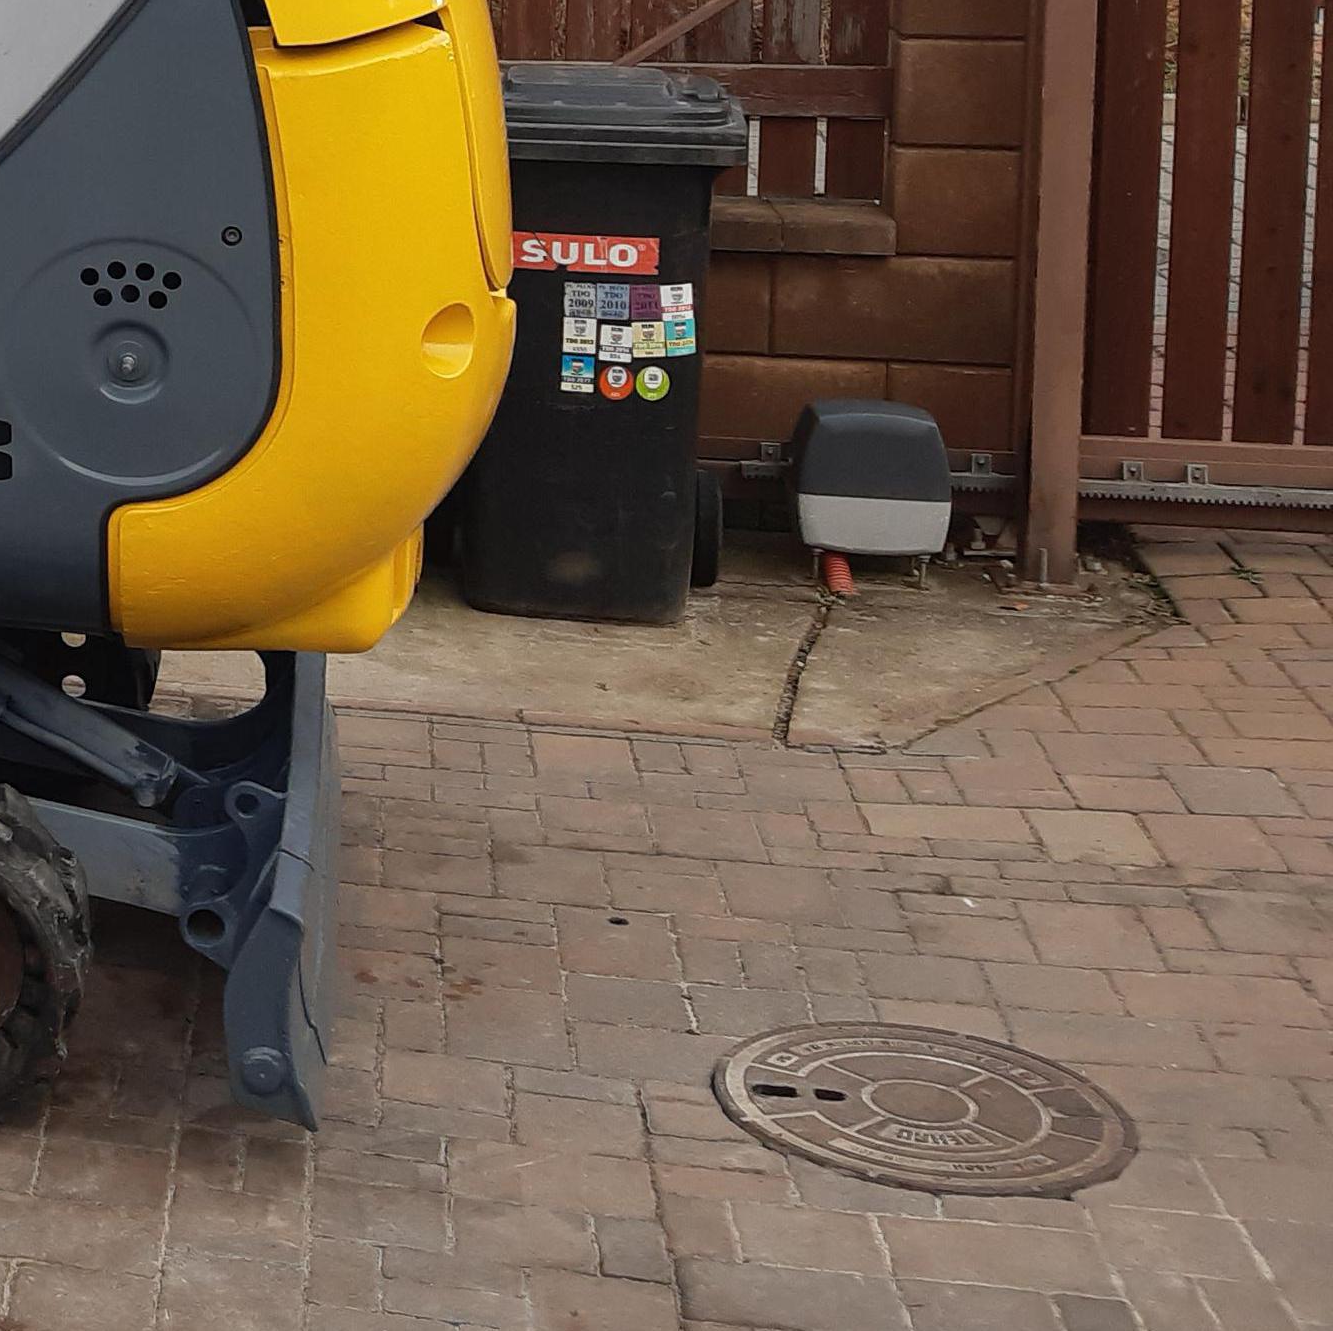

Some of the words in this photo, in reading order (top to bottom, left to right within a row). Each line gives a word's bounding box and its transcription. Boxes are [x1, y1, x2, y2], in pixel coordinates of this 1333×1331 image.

[520, 239, 638, 267] SULO
[568, 299, 594, 308] 2009
[599, 300, 627, 310] 2010
